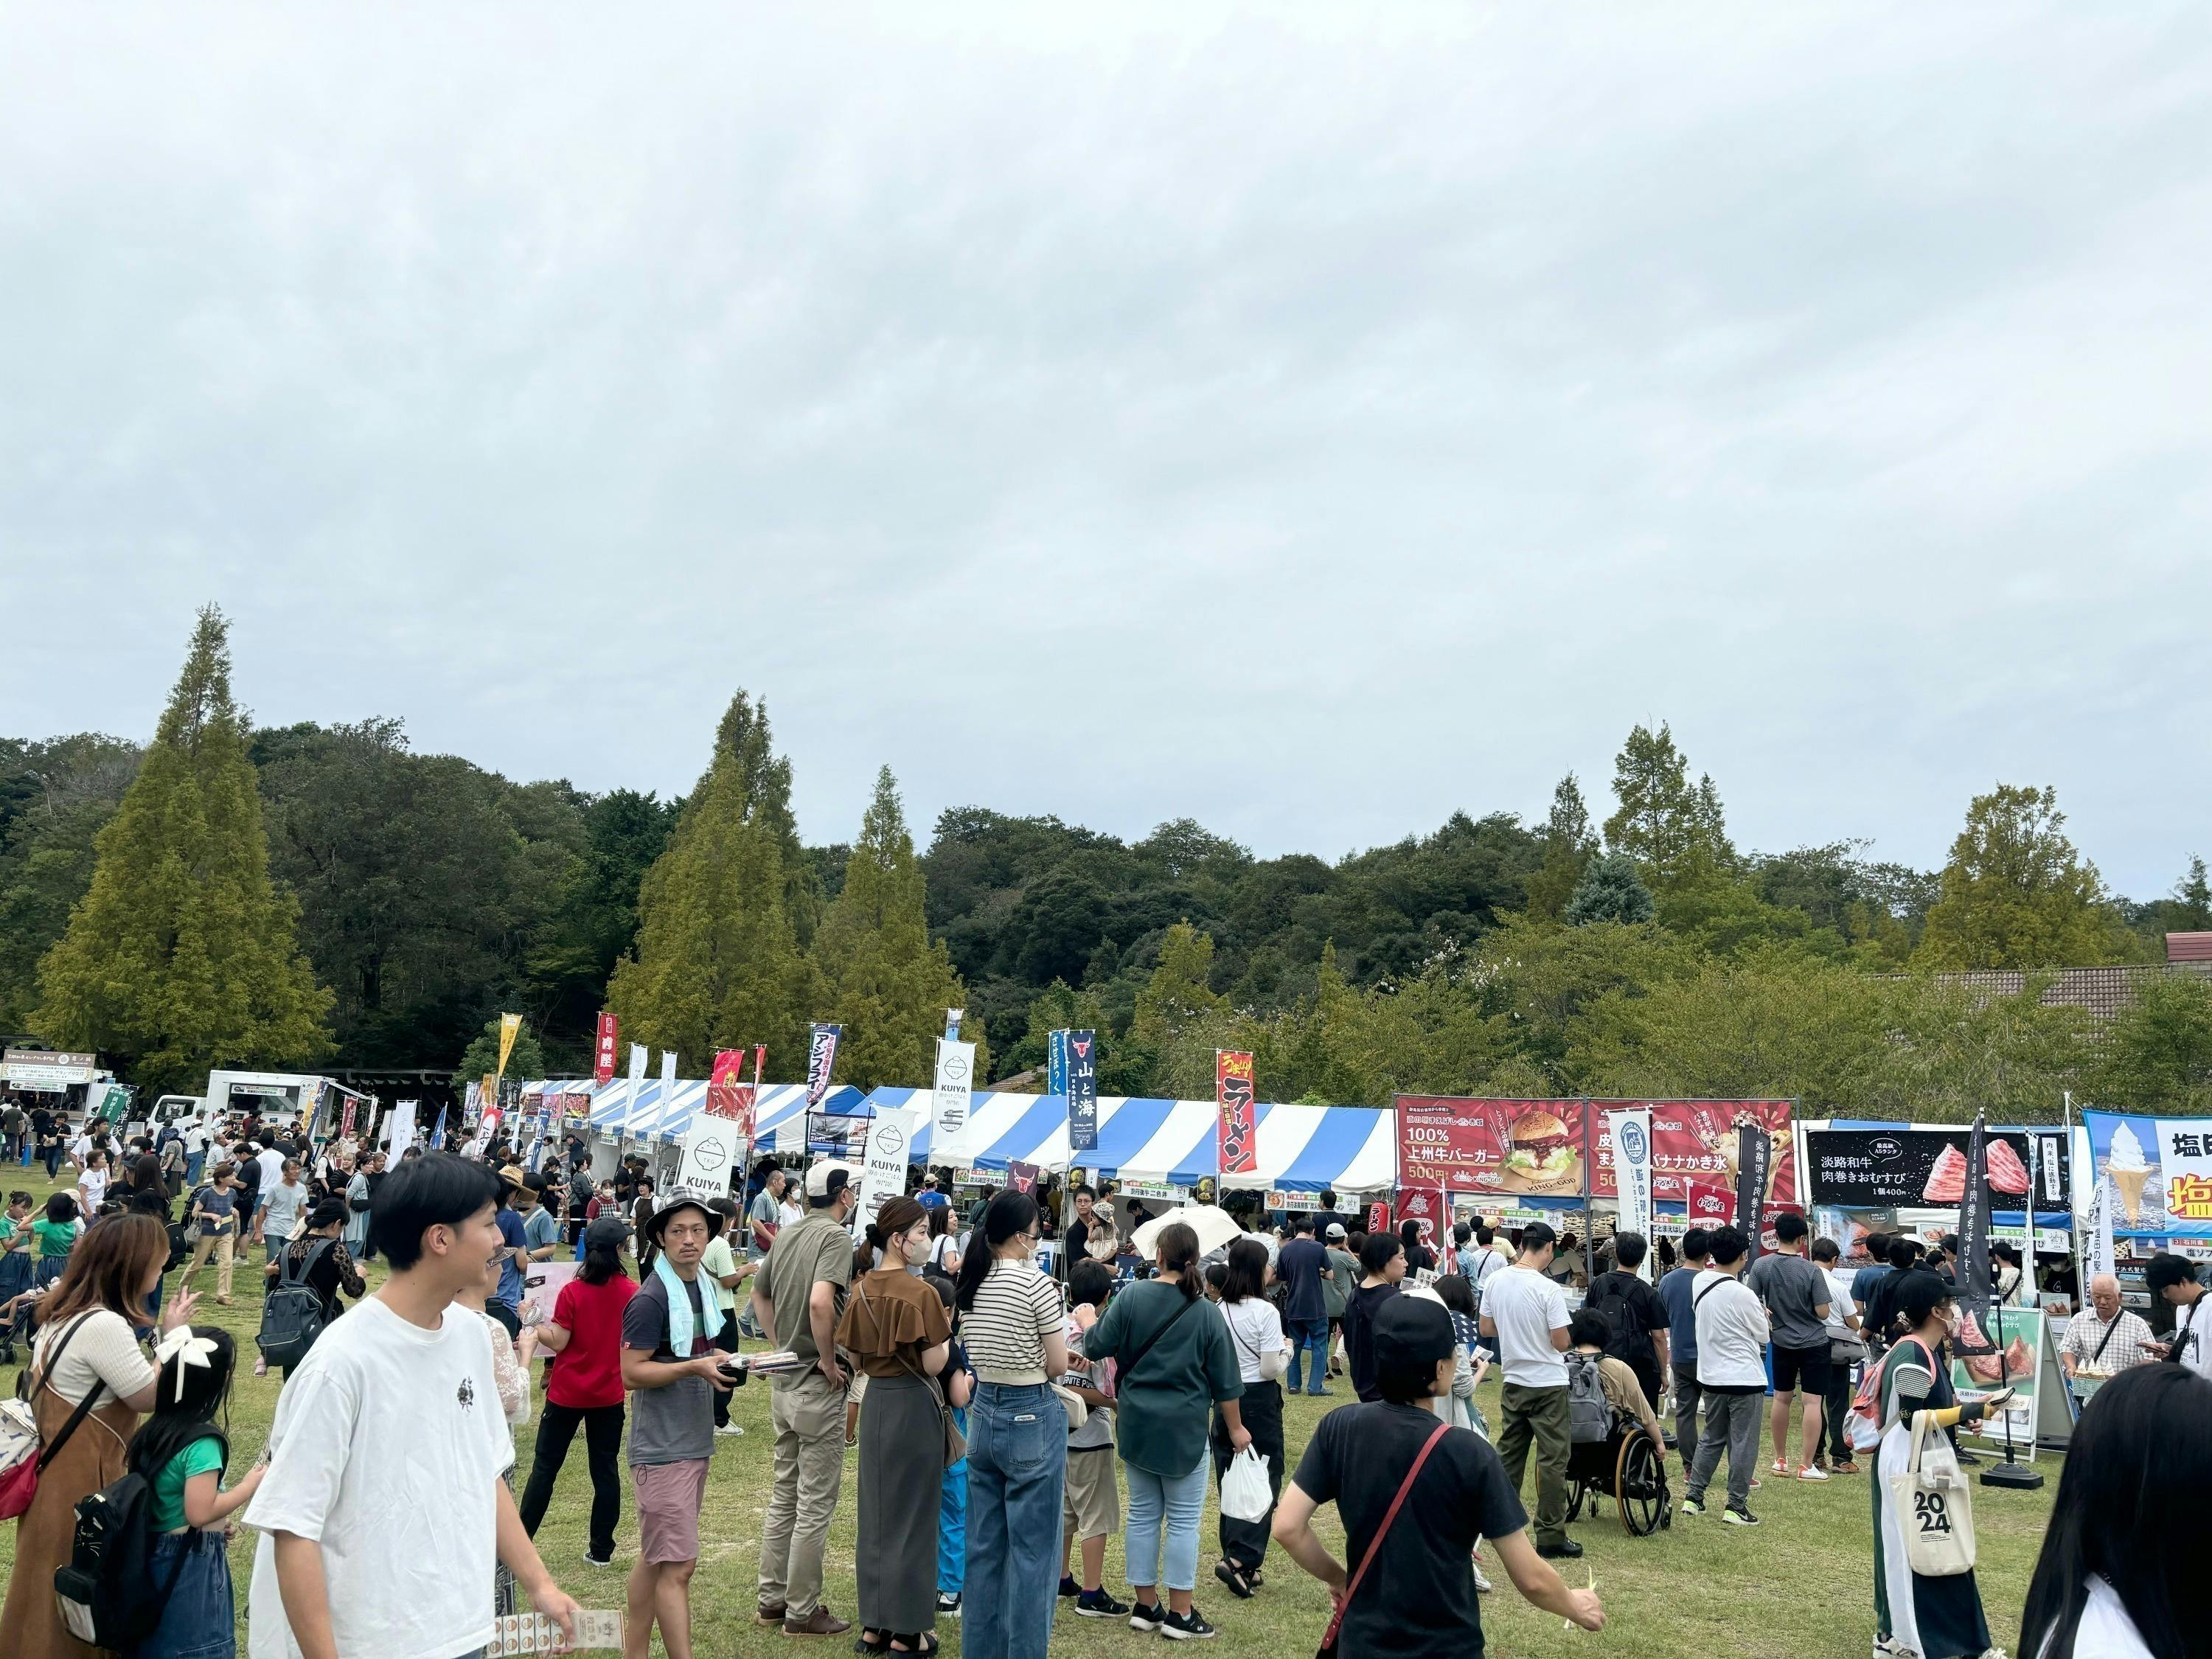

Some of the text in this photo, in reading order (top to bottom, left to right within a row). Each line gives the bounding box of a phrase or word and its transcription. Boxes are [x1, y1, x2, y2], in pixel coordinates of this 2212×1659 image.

[807, 1034, 829, 1090] アジフライ
[1052, 1036, 1062, 1096] させぼっく
[941, 1084, 966, 1093] KUIYA
[1078, 1061, 1095, 1117] 山と海
[1222, 1077, 1252, 1172] ラーメン
[1407, 1127, 1450, 1142] 100%
[1408, 1145, 1500, 1164] 上州牛バーガー
[1821, 1156, 1873, 1169] 淡路和牛
[871, 1159, 901, 1172] KUIYA
[686, 1176, 721, 1192] KUIYA
[1527, 1178, 1576, 1192] KING-GOD
[1821, 1171, 1906, 1184] 肉巻きおむすび
[1369, 1207, 1380, 1232] ラーメン
[2094, 1228, 2102, 1274] 塩田の聖
[1914, 1491, 1944, 1514] 20
[1916, 1511, 1951, 1533] 24
